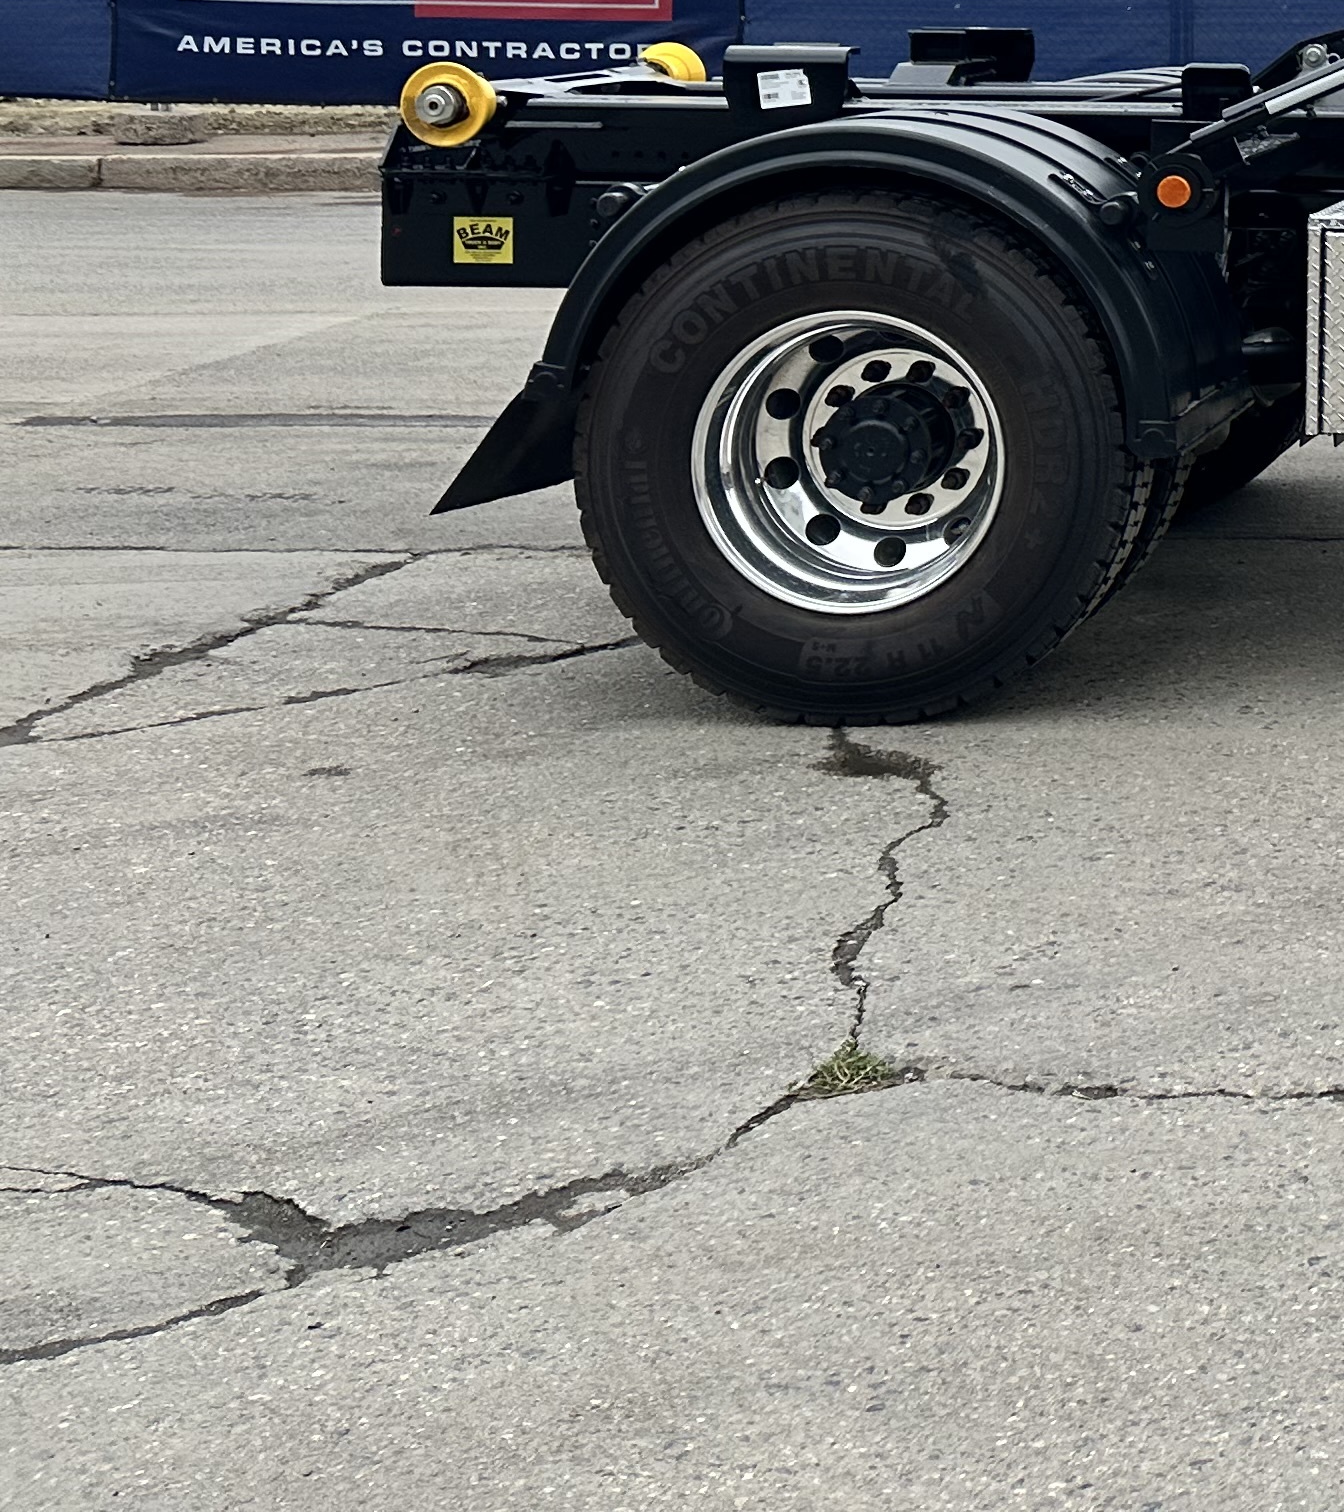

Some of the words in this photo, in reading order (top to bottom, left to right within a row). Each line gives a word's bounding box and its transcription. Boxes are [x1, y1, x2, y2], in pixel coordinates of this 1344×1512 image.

[177, 35, 383, 56] AMERICA'S
[456, 223, 510, 241] BEAM
[651, 245, 974, 374] CONTINENTAL
